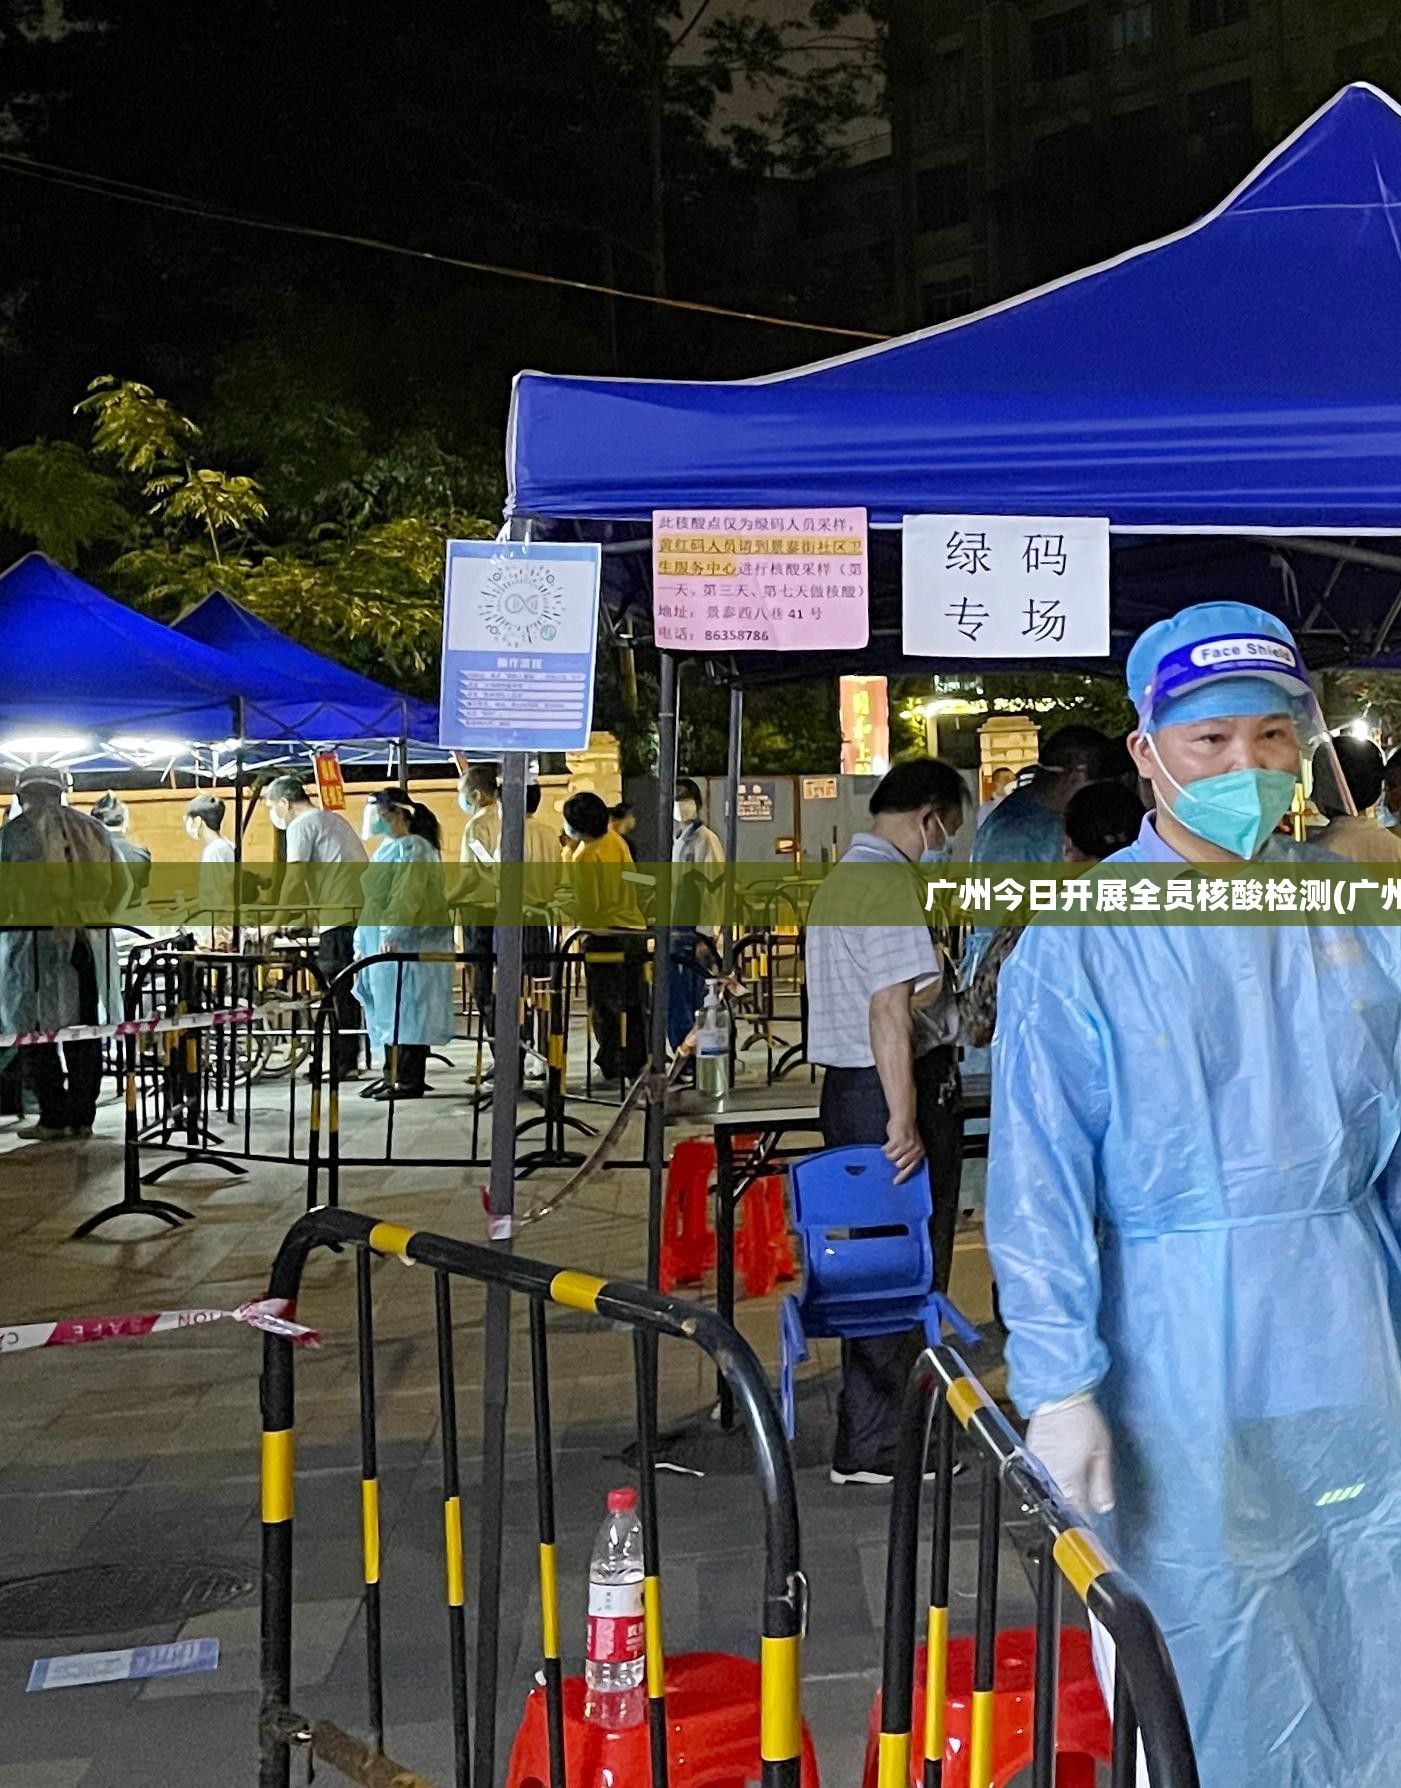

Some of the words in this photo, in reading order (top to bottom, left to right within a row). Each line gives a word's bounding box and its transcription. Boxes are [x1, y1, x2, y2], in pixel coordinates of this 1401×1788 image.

[945, 530, 1067, 576] 绿码
[944, 596, 1066, 642] 专场
[1201, 645, 1240, 661] Face
